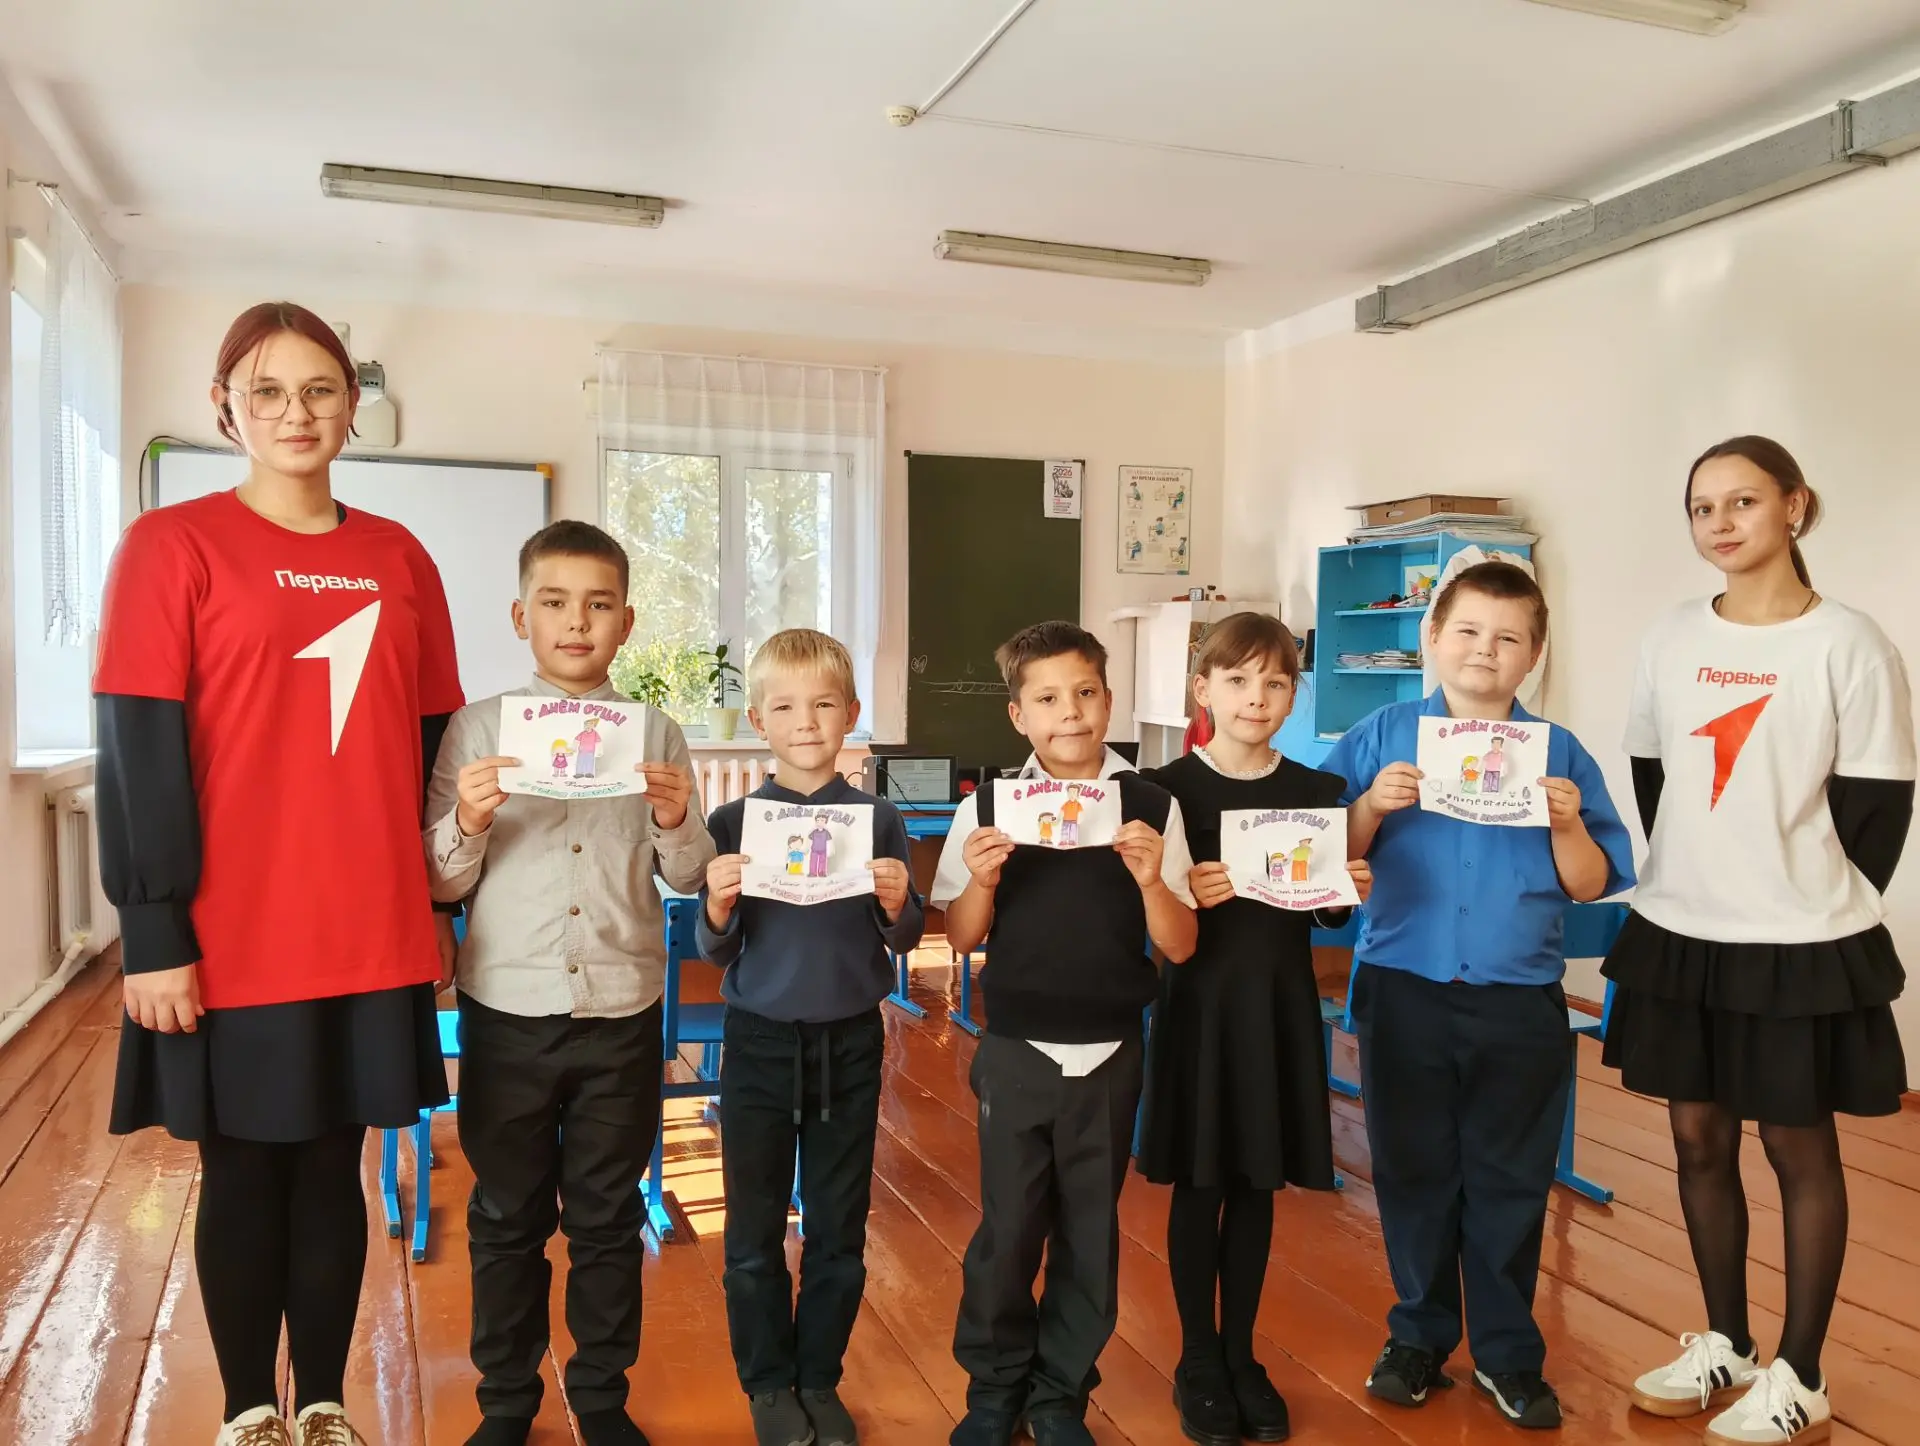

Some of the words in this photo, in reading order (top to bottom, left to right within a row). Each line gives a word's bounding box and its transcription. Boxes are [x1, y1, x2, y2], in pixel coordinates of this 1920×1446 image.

[274, 570, 379, 594] Первые
[1697, 667, 1777, 688] Первые
[523, 708, 533, 721] С
[539, 700, 580, 718] ДНЁМ
[584, 704, 627, 727] ОТЦА!
[1491, 723, 1531, 743] ОТЦА!
[1291, 812, 1330, 831] ОТЦА!
